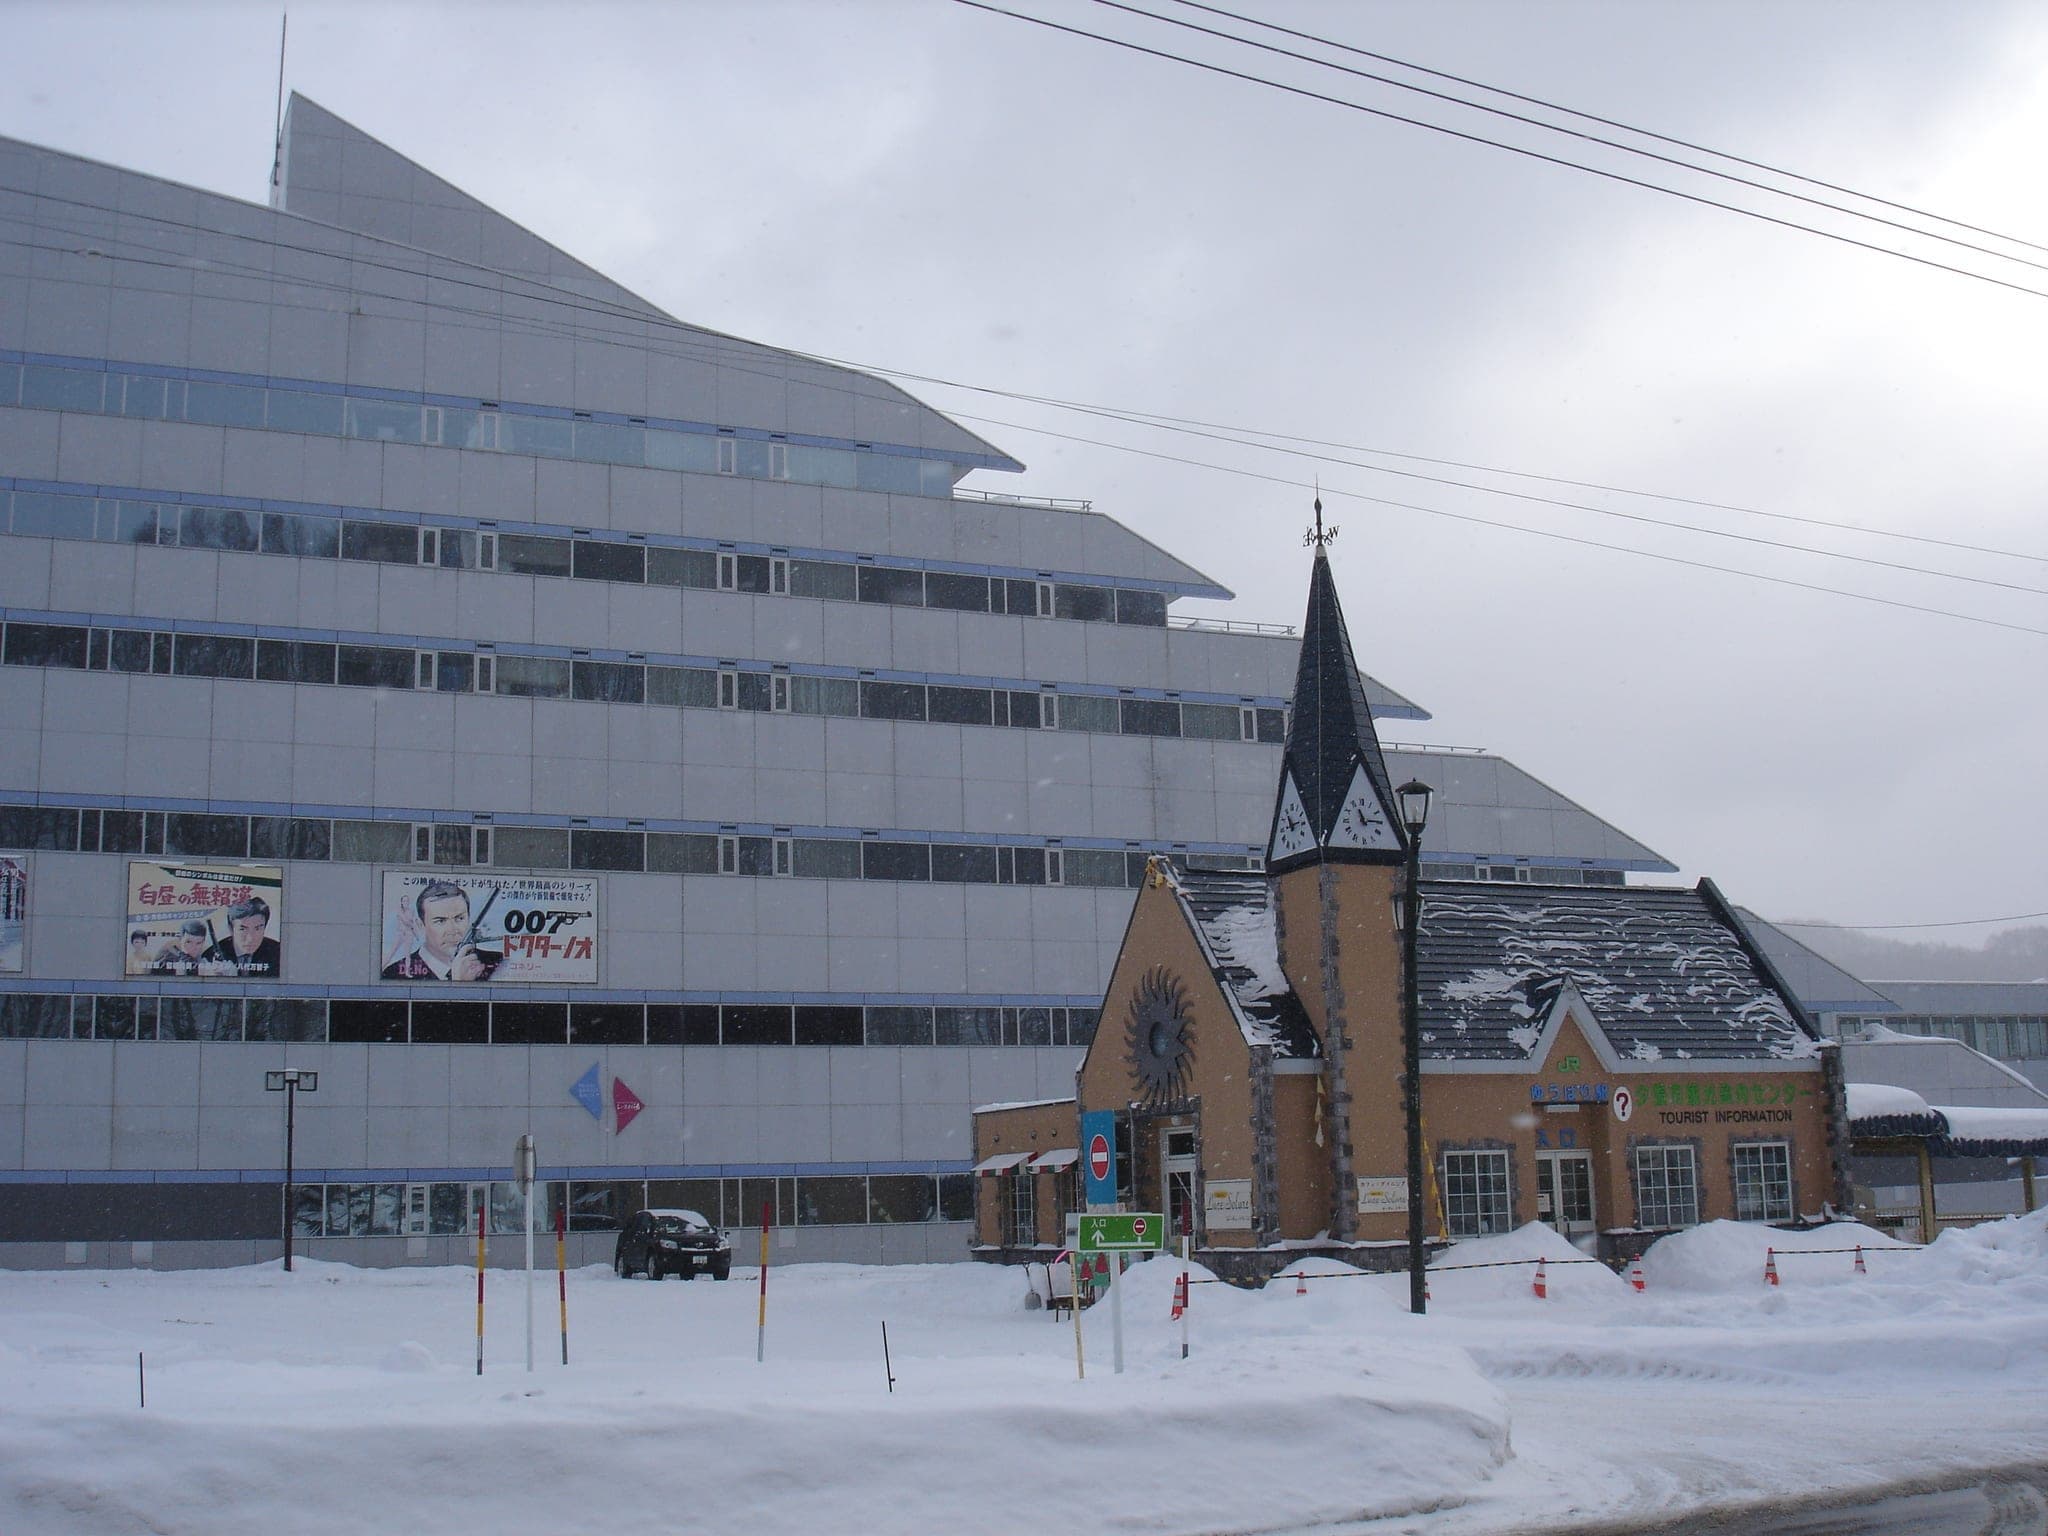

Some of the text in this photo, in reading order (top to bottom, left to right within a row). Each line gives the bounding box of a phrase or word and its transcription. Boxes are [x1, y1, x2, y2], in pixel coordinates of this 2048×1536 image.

[504, 909, 582, 933] 007
[1557, 1056, 1581, 1073] JR
[1531, 1083, 1609, 1102] ゆうばり駅
[1659, 1109, 1792, 1124] TOURIST INFORMATION
[1536, 1128, 1577, 1148] 入口
[1090, 1218, 1107, 1229] 入口
